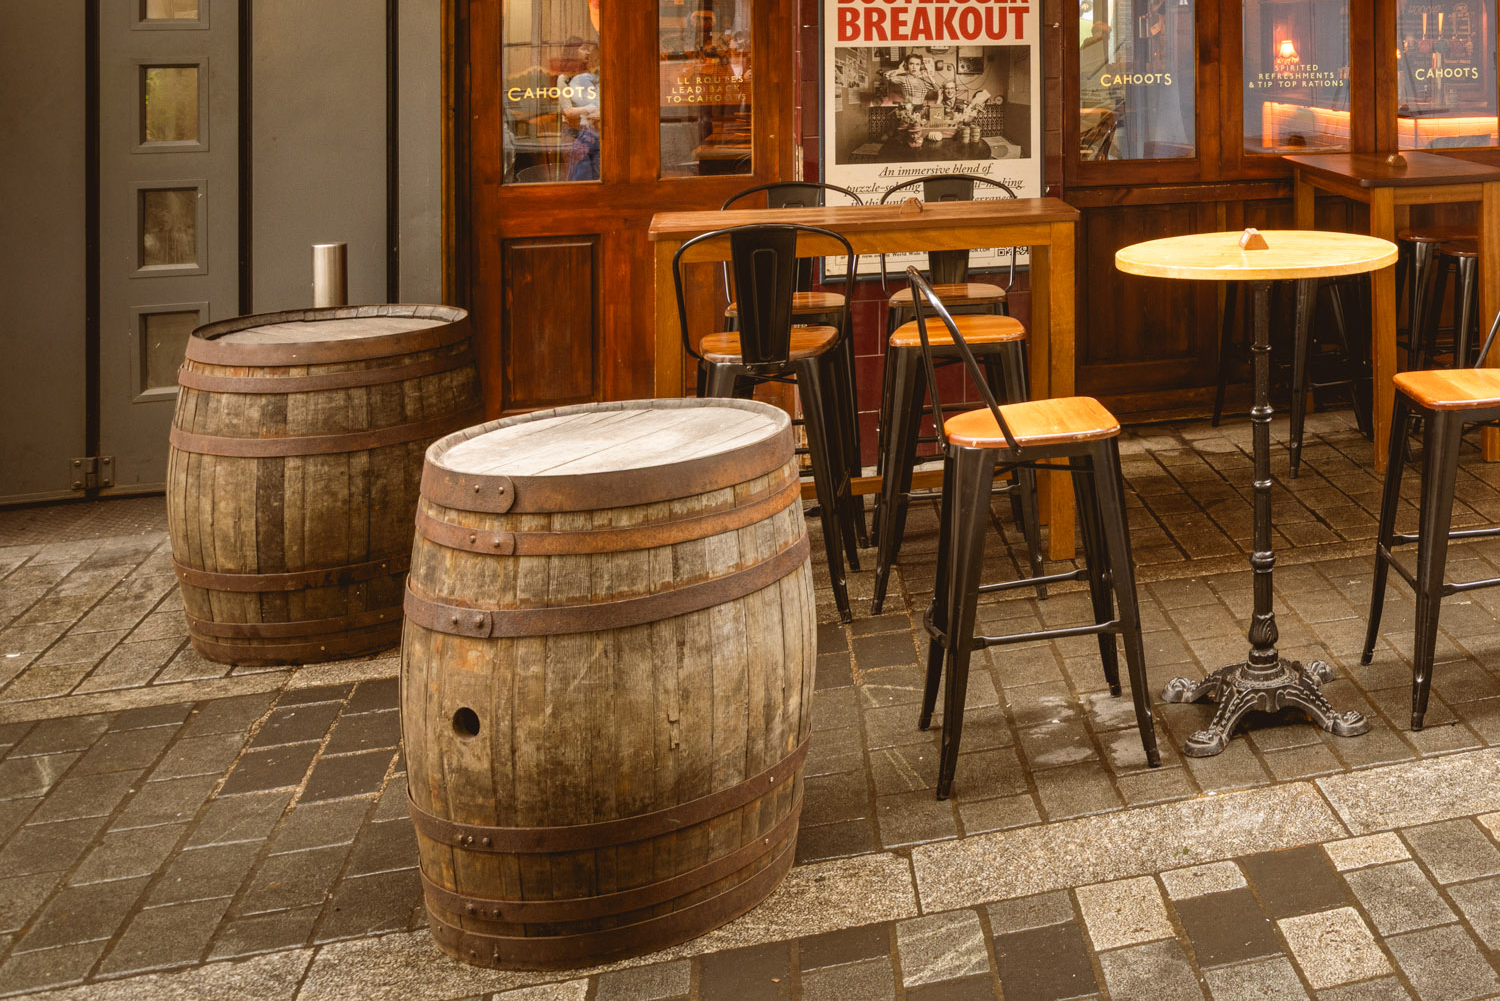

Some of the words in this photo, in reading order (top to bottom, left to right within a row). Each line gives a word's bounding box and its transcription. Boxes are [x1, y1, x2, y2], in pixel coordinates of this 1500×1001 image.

[837, 5, 1030, 42] BREAKOUT
[1274, 64, 1319, 72] SPIRITED
[1415, 67, 1479, 80] CAHOOTS
[1100, 73, 1173, 87] CAHOOTS
[1258, 72, 1335, 80] REFRESHMENTS
[672, 85, 703, 94] LEAD
[709, 84, 740, 93] BACK
[1301, 80, 1344, 88] RATIONS
[507, 86, 598, 102] CAHOOTS
[666, 95, 681, 103] TO
[879, 165, 895, 177] An
[897, 164, 951, 176] immersive
[952, 163, 980, 174] blend
[981, 162, 994, 176] of
